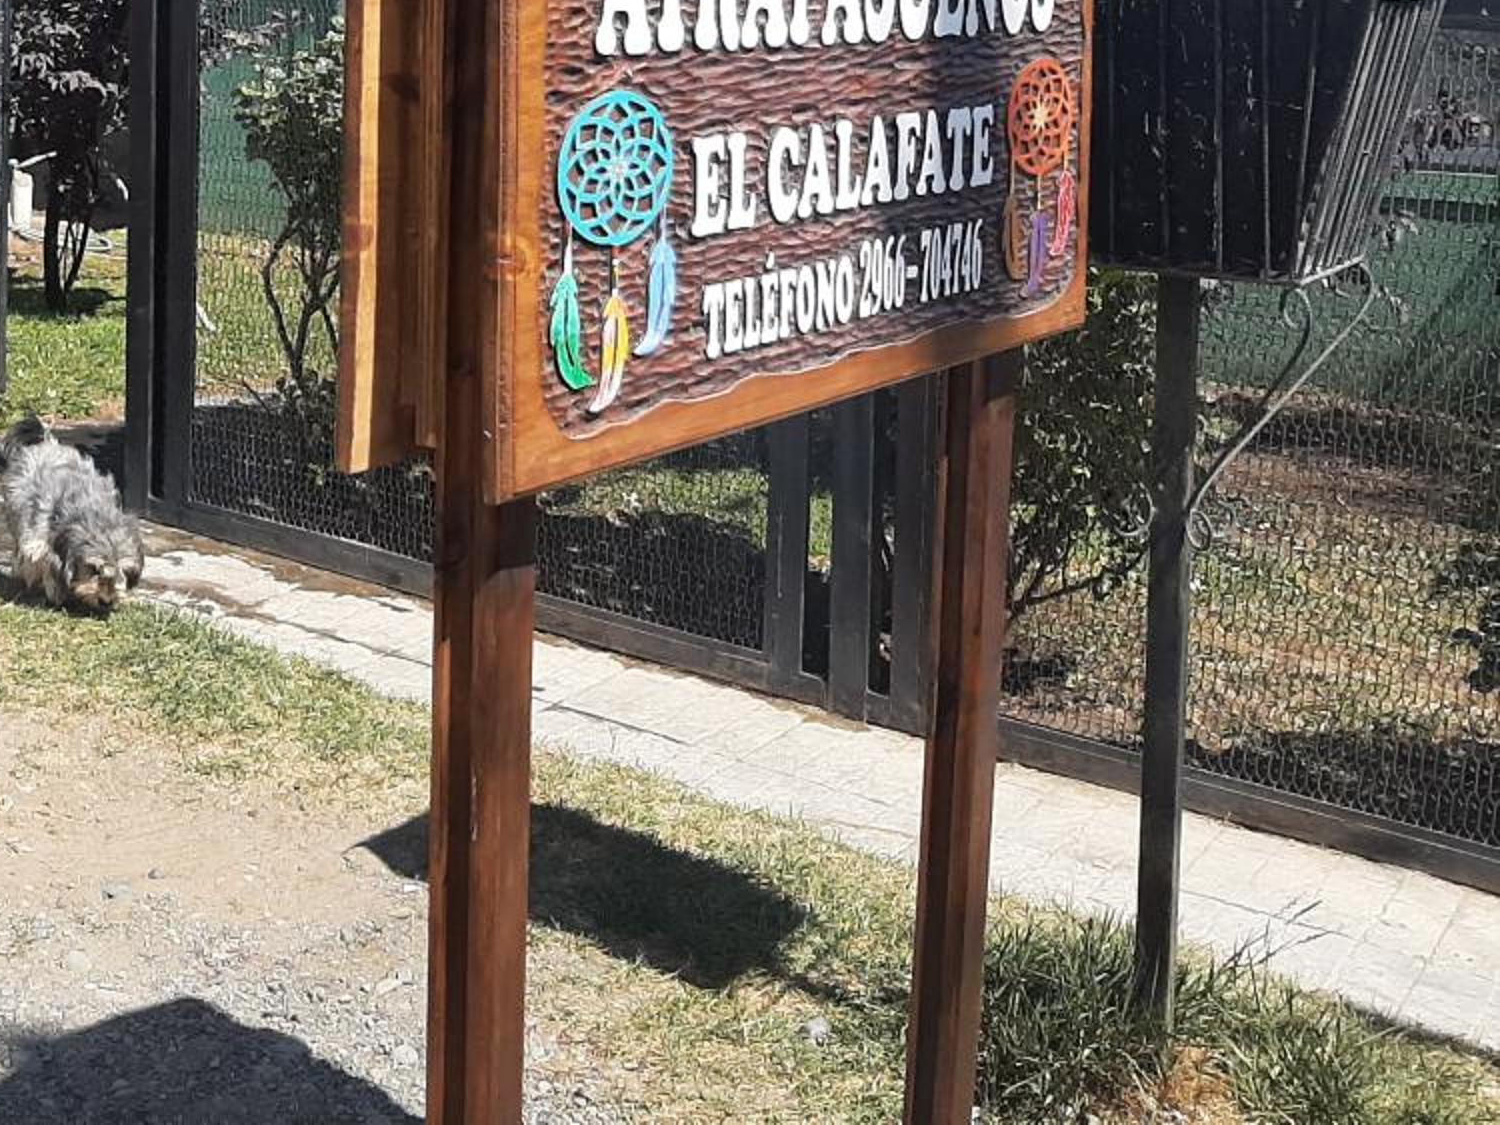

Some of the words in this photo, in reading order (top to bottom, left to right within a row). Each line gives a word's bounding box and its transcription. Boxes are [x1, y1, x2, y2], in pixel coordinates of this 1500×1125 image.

[691, 132, 757, 237] EL
[767, 104, 994, 223] CALAFATE
[703, 251, 852, 359] TELÉFONO
[859, 219, 983, 318] 2966-704746
